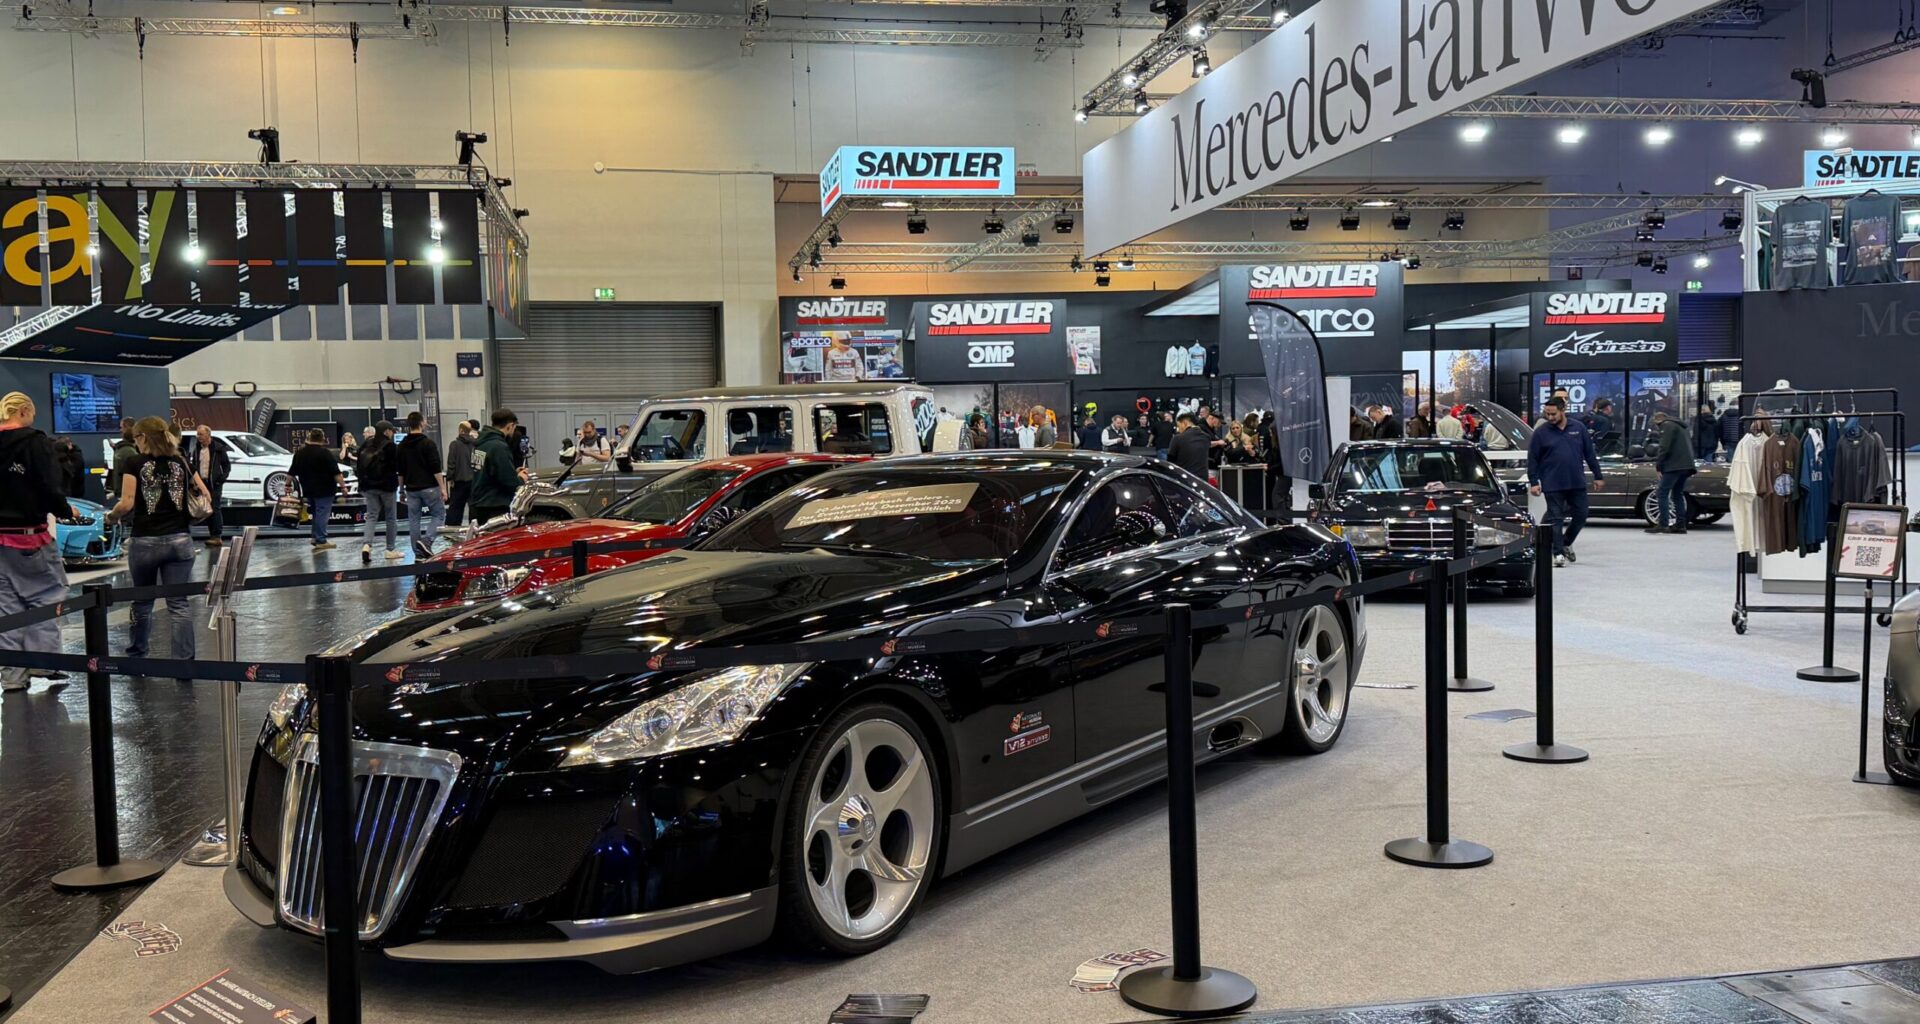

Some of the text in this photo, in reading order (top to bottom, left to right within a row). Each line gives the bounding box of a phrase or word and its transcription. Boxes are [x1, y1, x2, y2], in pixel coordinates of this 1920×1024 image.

[1169, 0, 1653, 212] Mercedes-Fan
[856, 151, 1003, 177] SANDTLER
[0, 191, 176, 300] ay
[1250, 265, 1379, 289] SANDTLER
[797, 301, 887, 318] SANDTLER
[929, 302, 1053, 325] SANDTLER
[1547, 292, 1667, 314] SANDTLER
[114, 303, 241, 327] No Limits
[1248, 308, 1375, 332] sparco
[791, 337, 831, 346] sparco
[1579, 340, 1666, 356] alpinestars
[968, 346, 1015, 363] OMP
[816, 511, 843, 519] Event
[880, 501, 933, 511] Dezember
[933, 498, 961, 506] 2025
[858, 498, 904, 509] Maybach
[905, 494, 943, 504] Exelero
[871, 509, 902, 517] Stand
[903, 505, 952, 514] erhältlich
[1008, 738, 1026, 751] V12
